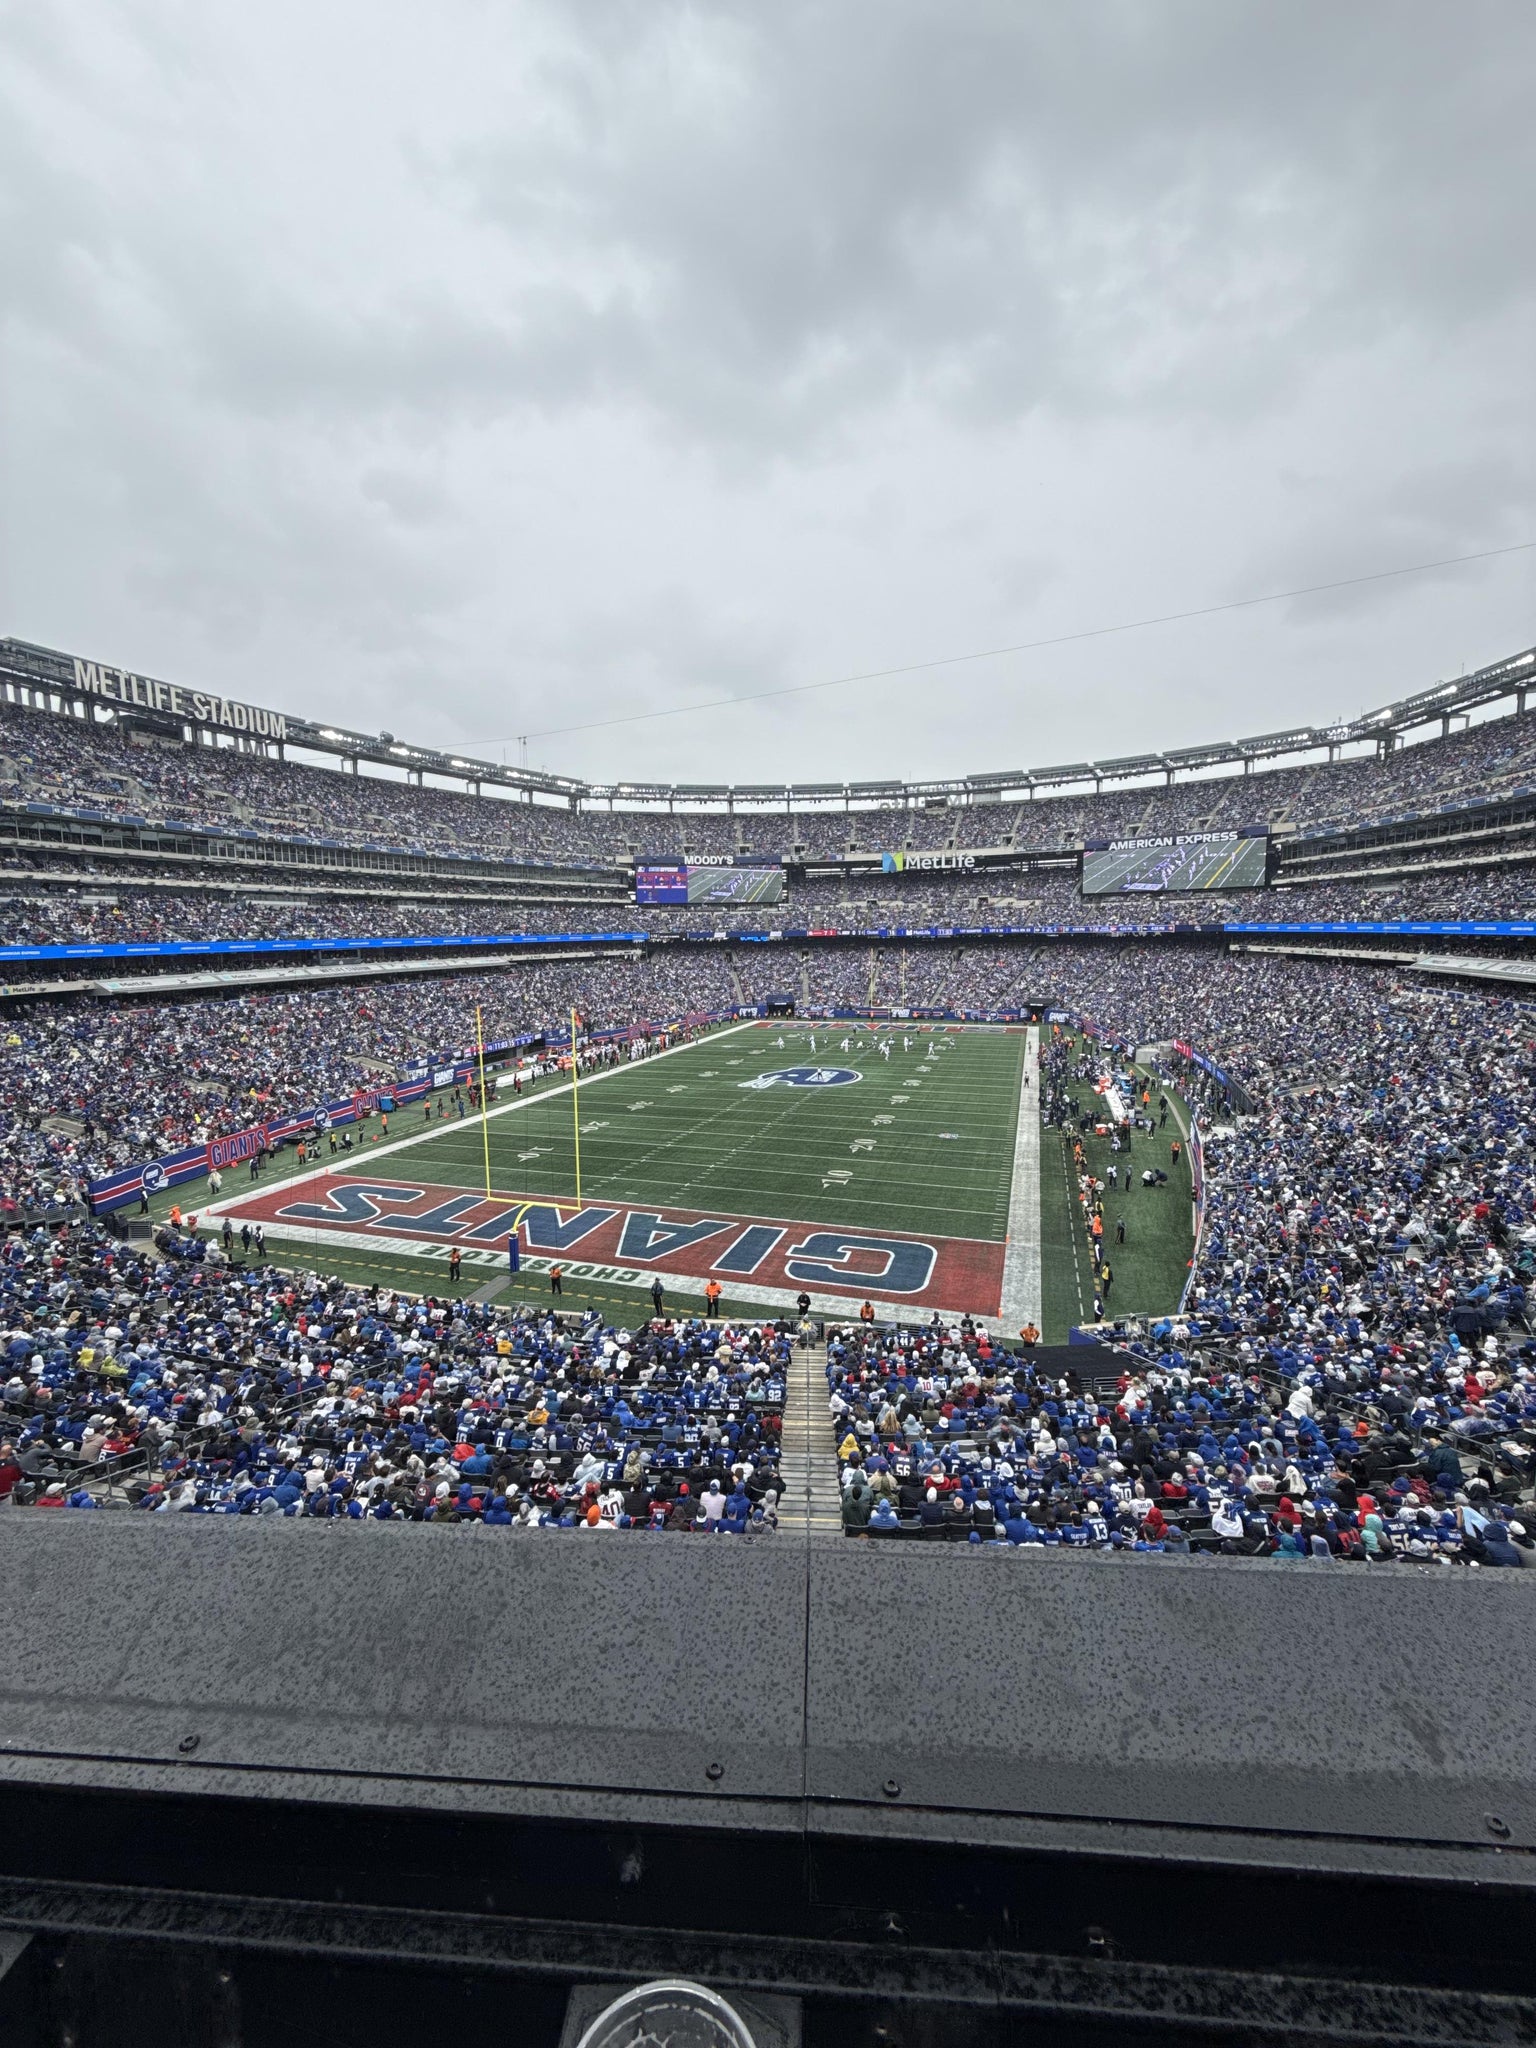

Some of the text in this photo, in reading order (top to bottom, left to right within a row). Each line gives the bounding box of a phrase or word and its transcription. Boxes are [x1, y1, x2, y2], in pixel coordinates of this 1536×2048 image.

[73, 658, 287, 740] METLIFE STADIUM
[1109, 831, 1238, 851] AMERICAN EXPRESS
[684, 855, 734, 865] MOODY'S
[905, 852, 975, 870] MetLife
[434, 1068, 454, 1084] GIANTS
[211, 1128, 267, 1167] GIANTS
[849, 1138, 878, 1153] 20
[517, 1145, 554, 1163] 10
[821, 1169, 854, 1188] 10
[275, 1183, 939, 1296] GIANTS
[419, 1244, 502, 1265] LOVE
[922, 1381, 931, 1391] 10
[768, 1389, 781, 1401] 92
[576, 1437, 592, 1452] 56
[344, 1462, 356, 1475] 13
[677, 1456, 684, 1468] 5
[606, 1467, 615, 1480] 5
[896, 1464, 911, 1476] 56
[268, 1474, 275, 1486] 9
[602, 1500, 620, 1516] 40
[1093, 1523, 1108, 1541] 13
[1388, 1523, 1407, 1532] TAYLOR
